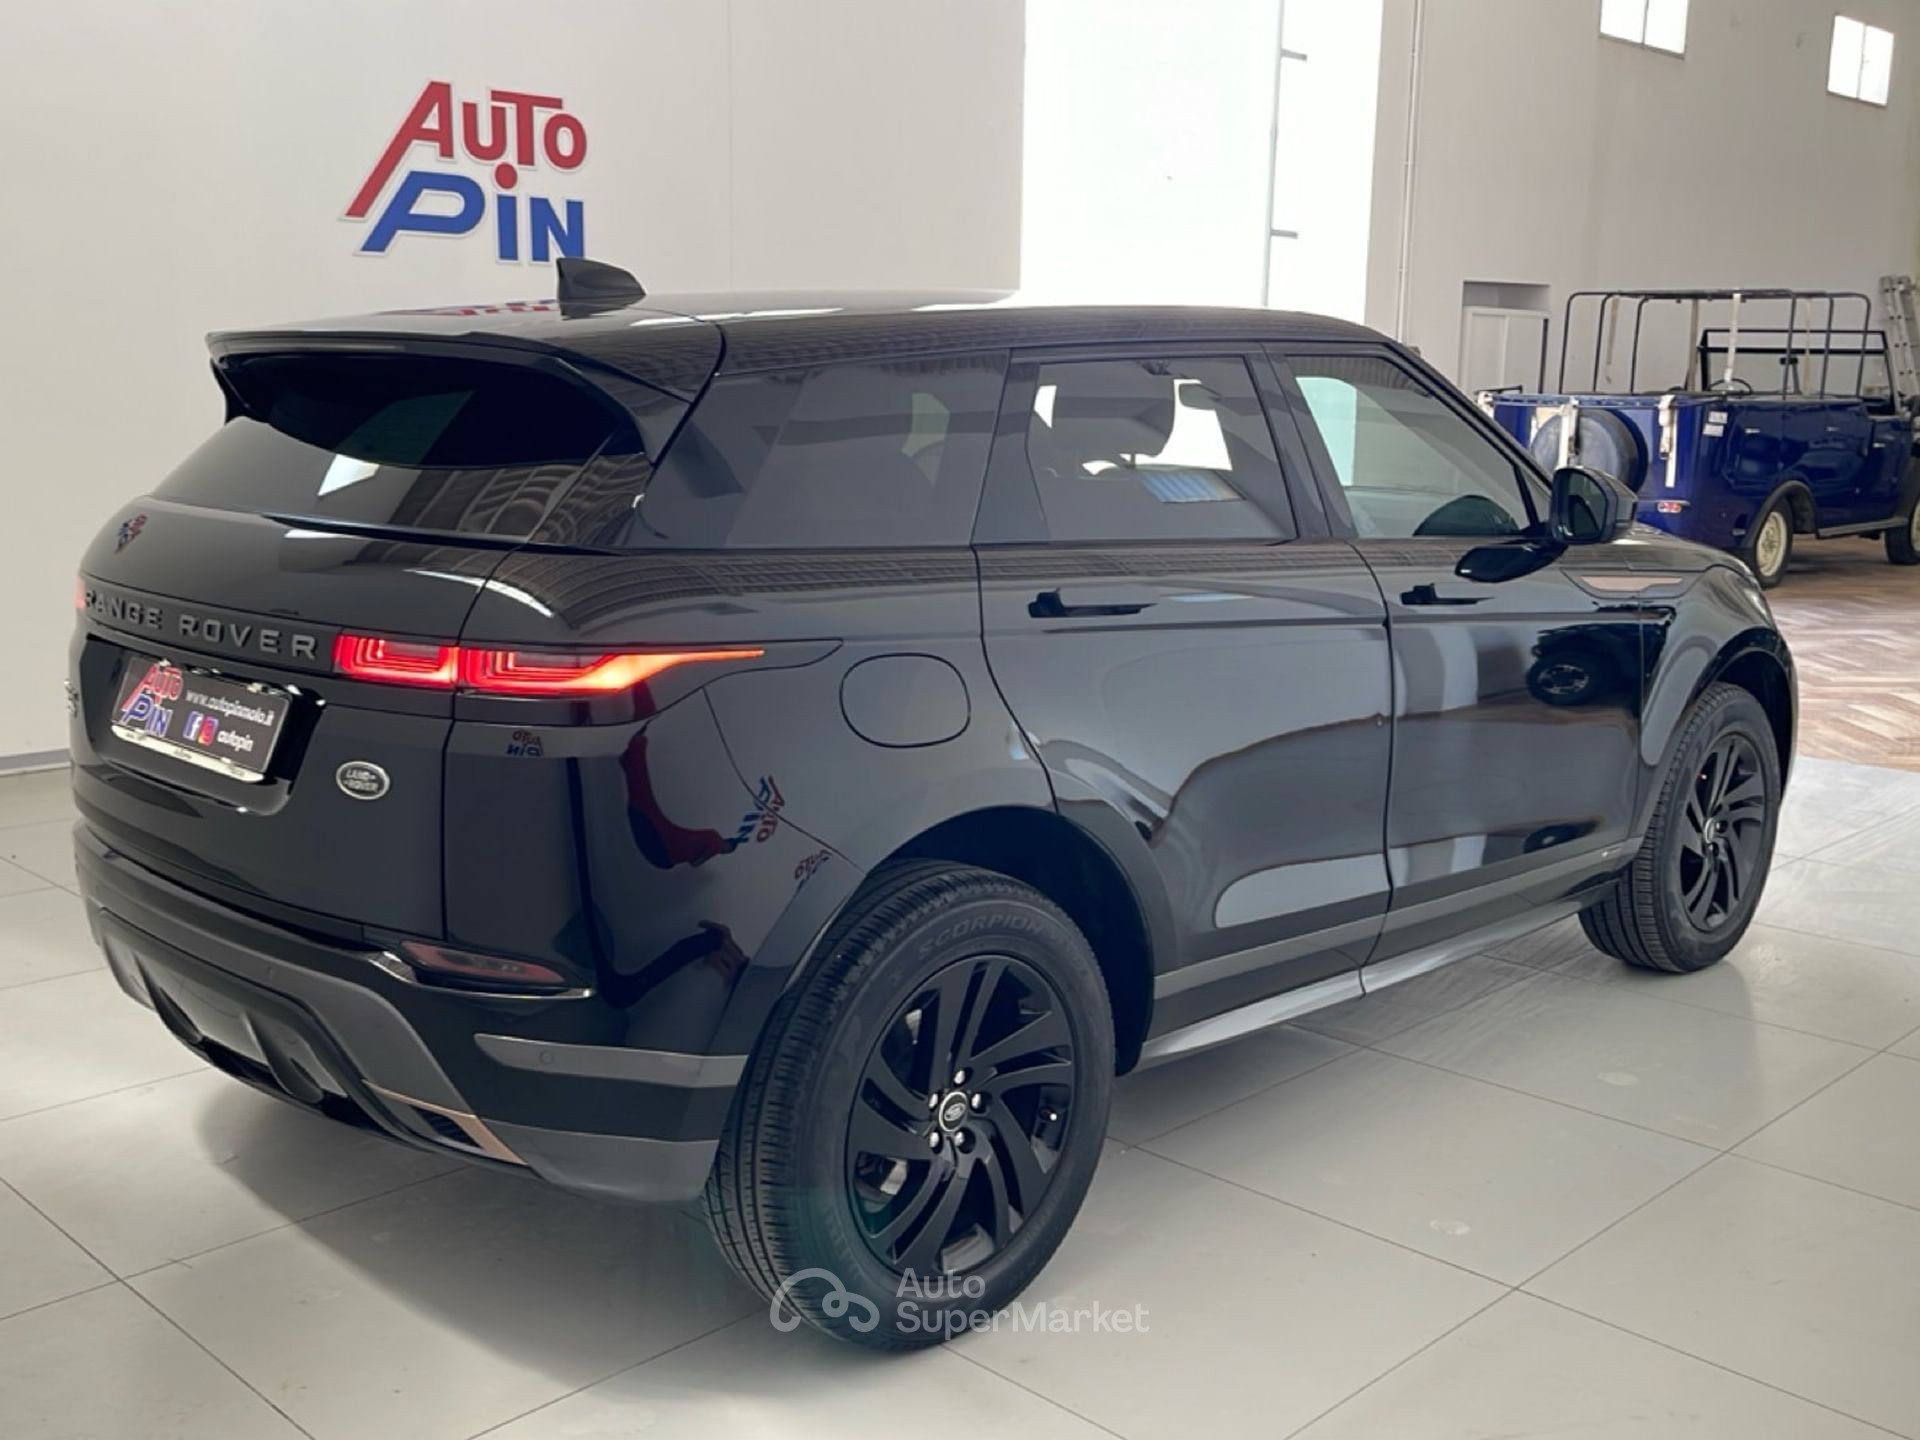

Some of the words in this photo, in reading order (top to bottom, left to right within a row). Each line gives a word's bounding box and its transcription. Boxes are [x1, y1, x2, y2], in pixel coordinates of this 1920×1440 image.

[85, 589, 162, 630] RANGE
[179, 613, 317, 662] ROVER
[918, 913, 1044, 960] SCORPION
